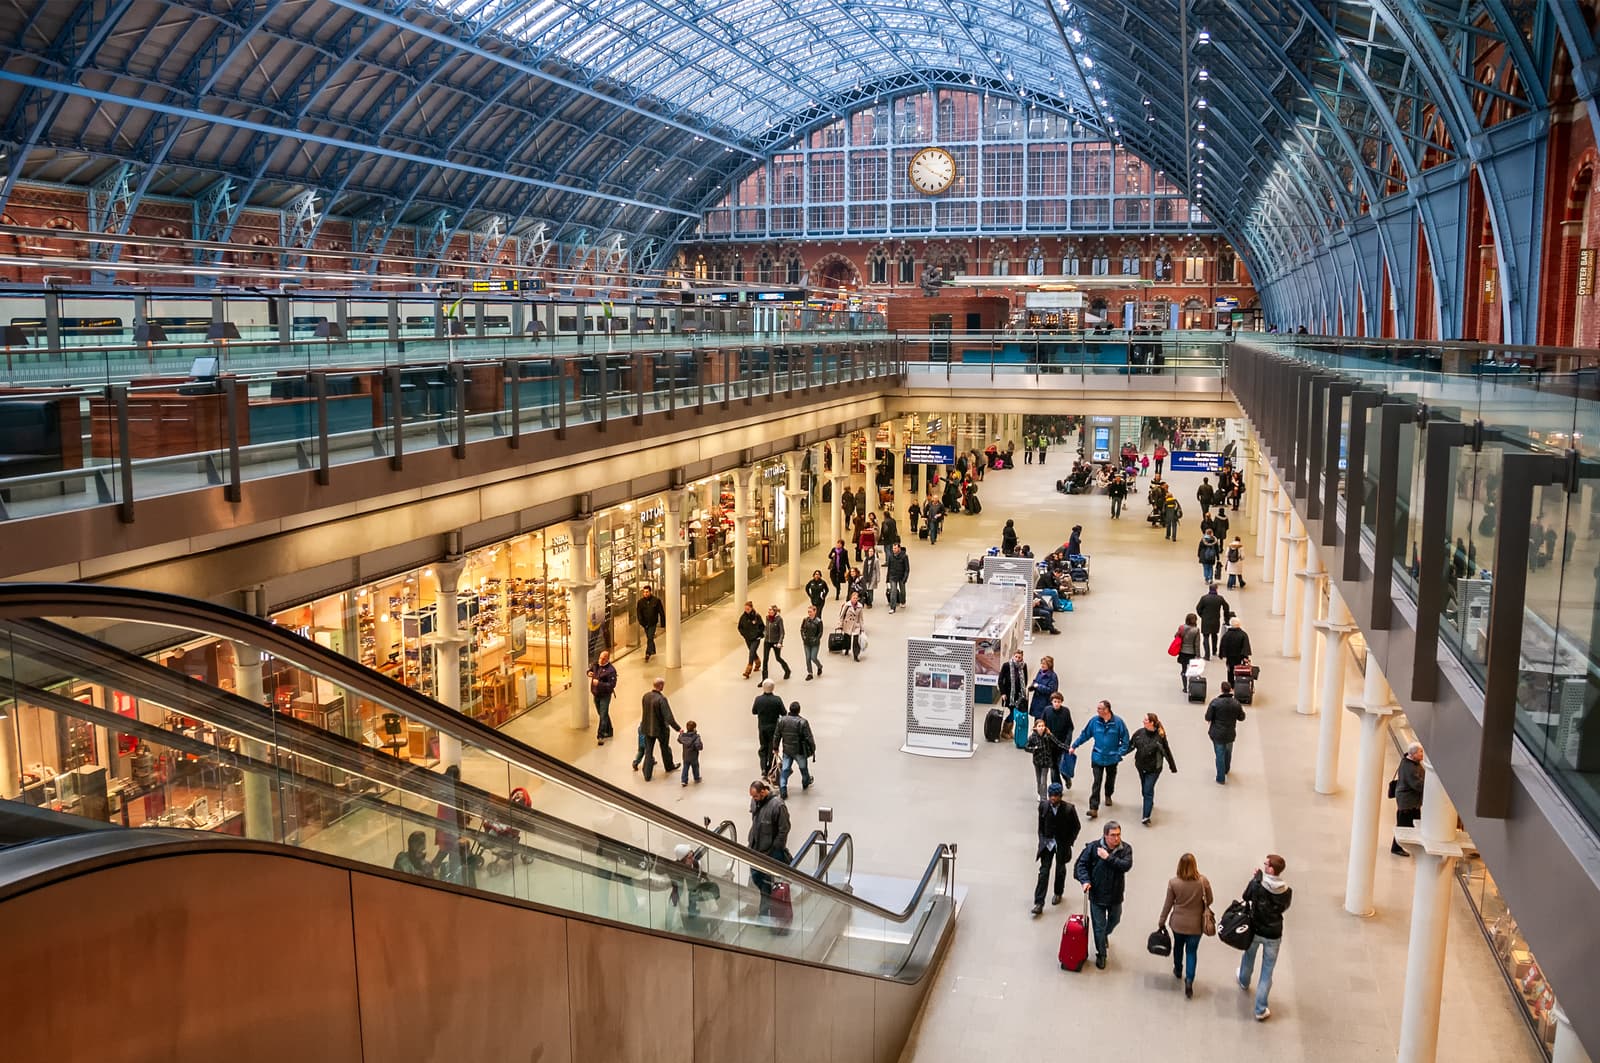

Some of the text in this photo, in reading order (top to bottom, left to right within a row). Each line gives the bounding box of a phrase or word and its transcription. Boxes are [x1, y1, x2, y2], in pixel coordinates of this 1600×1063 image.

[1578, 250, 1588, 295] OYSTER BAR
[640, 504, 664, 523] RITUA
